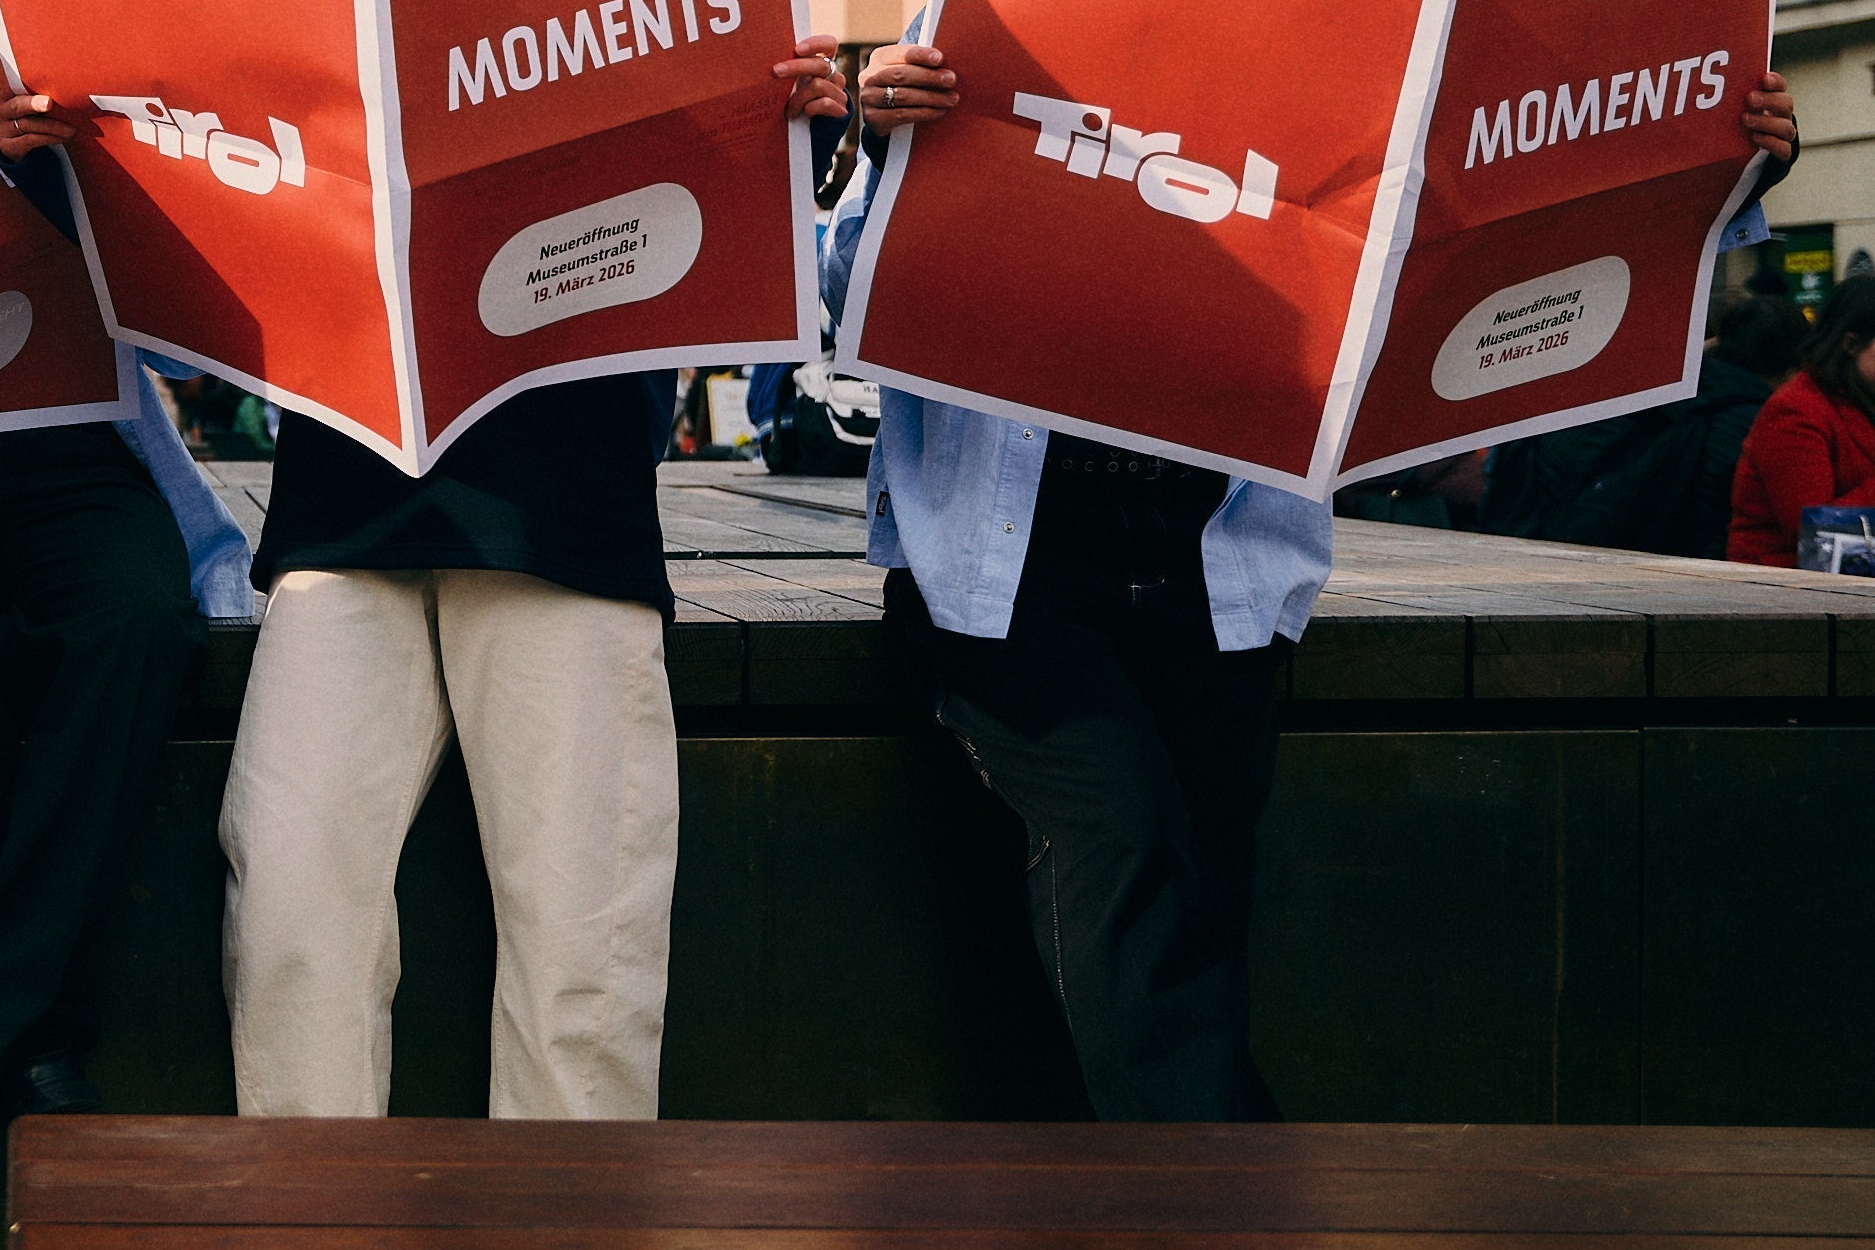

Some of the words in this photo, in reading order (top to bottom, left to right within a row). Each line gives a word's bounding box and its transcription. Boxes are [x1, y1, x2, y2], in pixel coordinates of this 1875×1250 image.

[1465, 50, 1729, 169] MOMENTS
[89, 95, 307, 195] Tirol
[1013, 92, 1279, 223] Tirol
[525, 239, 637, 286] Museumstraße
[641, 234, 648, 248] 1
[539, 218, 640, 260] Neueröffnung
[533, 287, 552, 303] 19.
[555, 275, 594, 296] März
[598, 259, 635, 283] 2026
[1476, 310, 1575, 350] Museumstraße
[1578, 305, 1584, 319] 1
[1493, 289, 1582, 325] Neueröffnung
[1479, 353, 1495, 370] 19.
[1498, 344, 1534, 363] März
[1537, 331, 1569, 353] 2026
